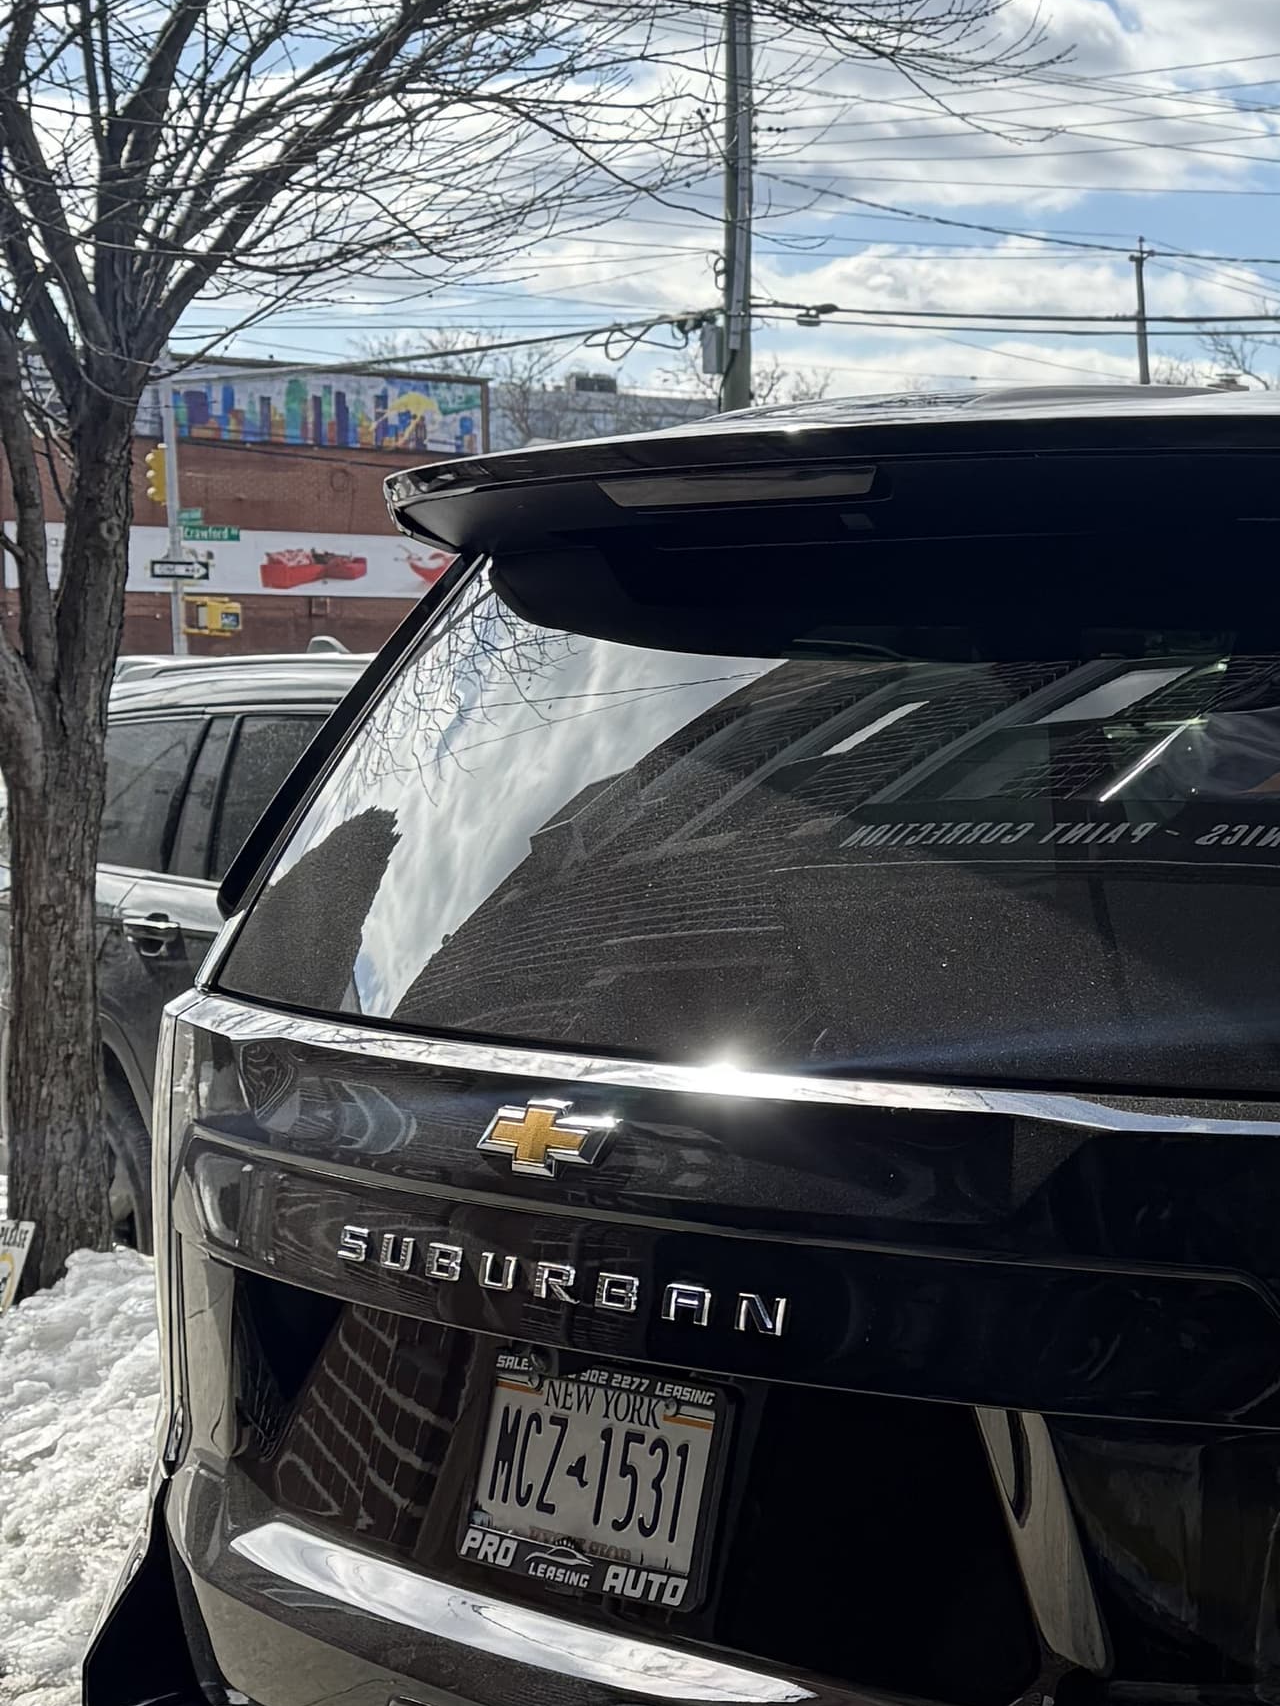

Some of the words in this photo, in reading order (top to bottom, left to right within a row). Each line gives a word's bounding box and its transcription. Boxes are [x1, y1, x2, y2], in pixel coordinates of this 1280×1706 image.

[337, 1225, 788, 1337] SUBURBAN
[496, 1354, 534, 1372] SALE
[611, 1372, 650, 1393] 2277
[655, 1381, 716, 1406] LEASING
[544, 1378, 595, 1415] NEW
[599, 1388, 661, 1430] YORK
[488, 1405, 569, 1515] MCZ
[592, 1426, 690, 1543] 1531
[460, 1529, 519, 1568] PRO
[602, 1564, 689, 1607] AUTO
[528, 1562, 591, 1589] LEASING
